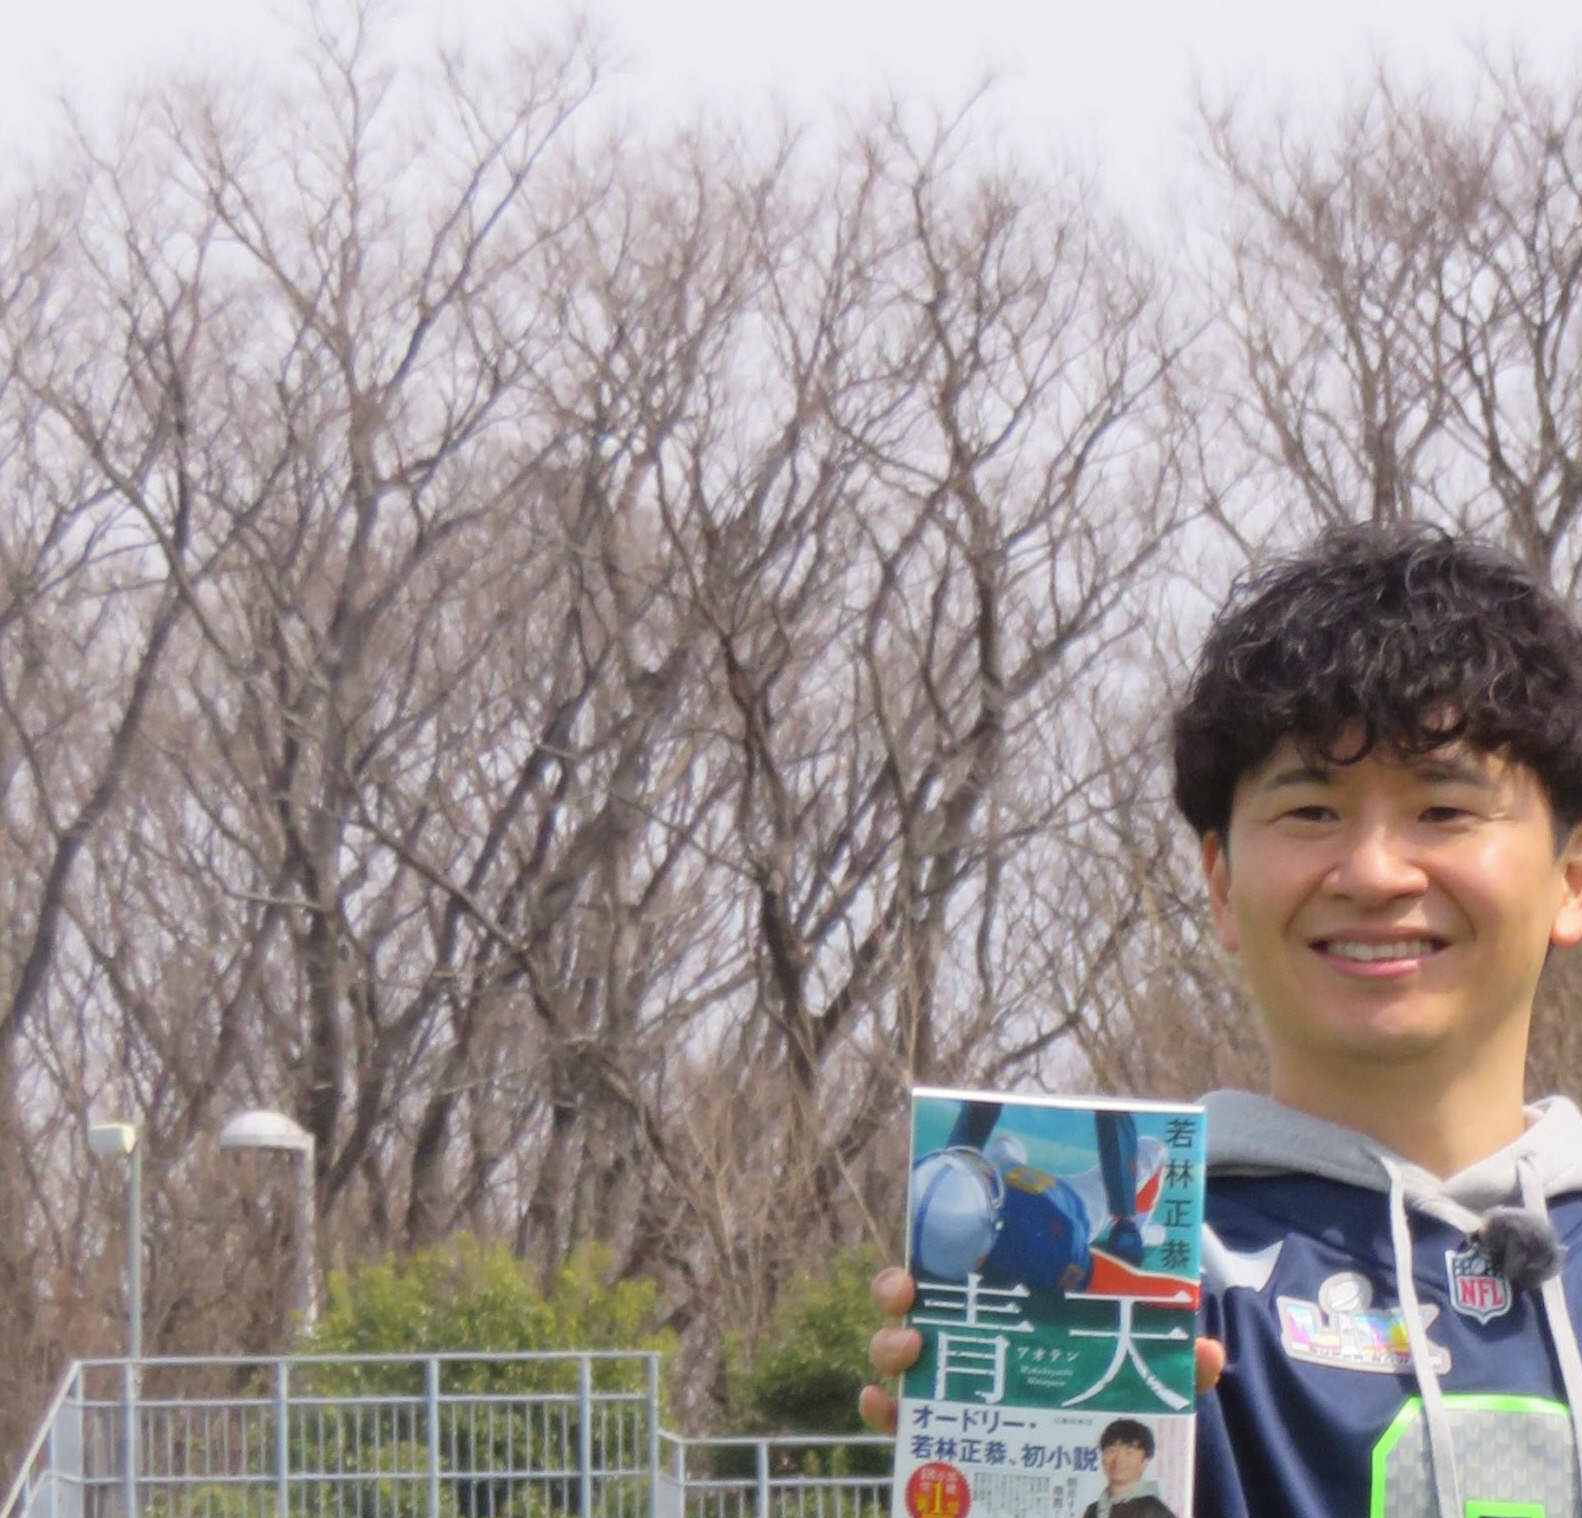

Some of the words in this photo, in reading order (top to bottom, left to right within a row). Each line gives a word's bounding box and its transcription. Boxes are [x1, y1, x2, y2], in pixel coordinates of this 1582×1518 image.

[1161, 1118, 1197, 1270] 若林正恭
[1458, 1278, 1507, 1310] NFL
[911, 1273, 1195, 1411] 青天
[911, 1434, 1099, 1471] 若林正恭、初小説
